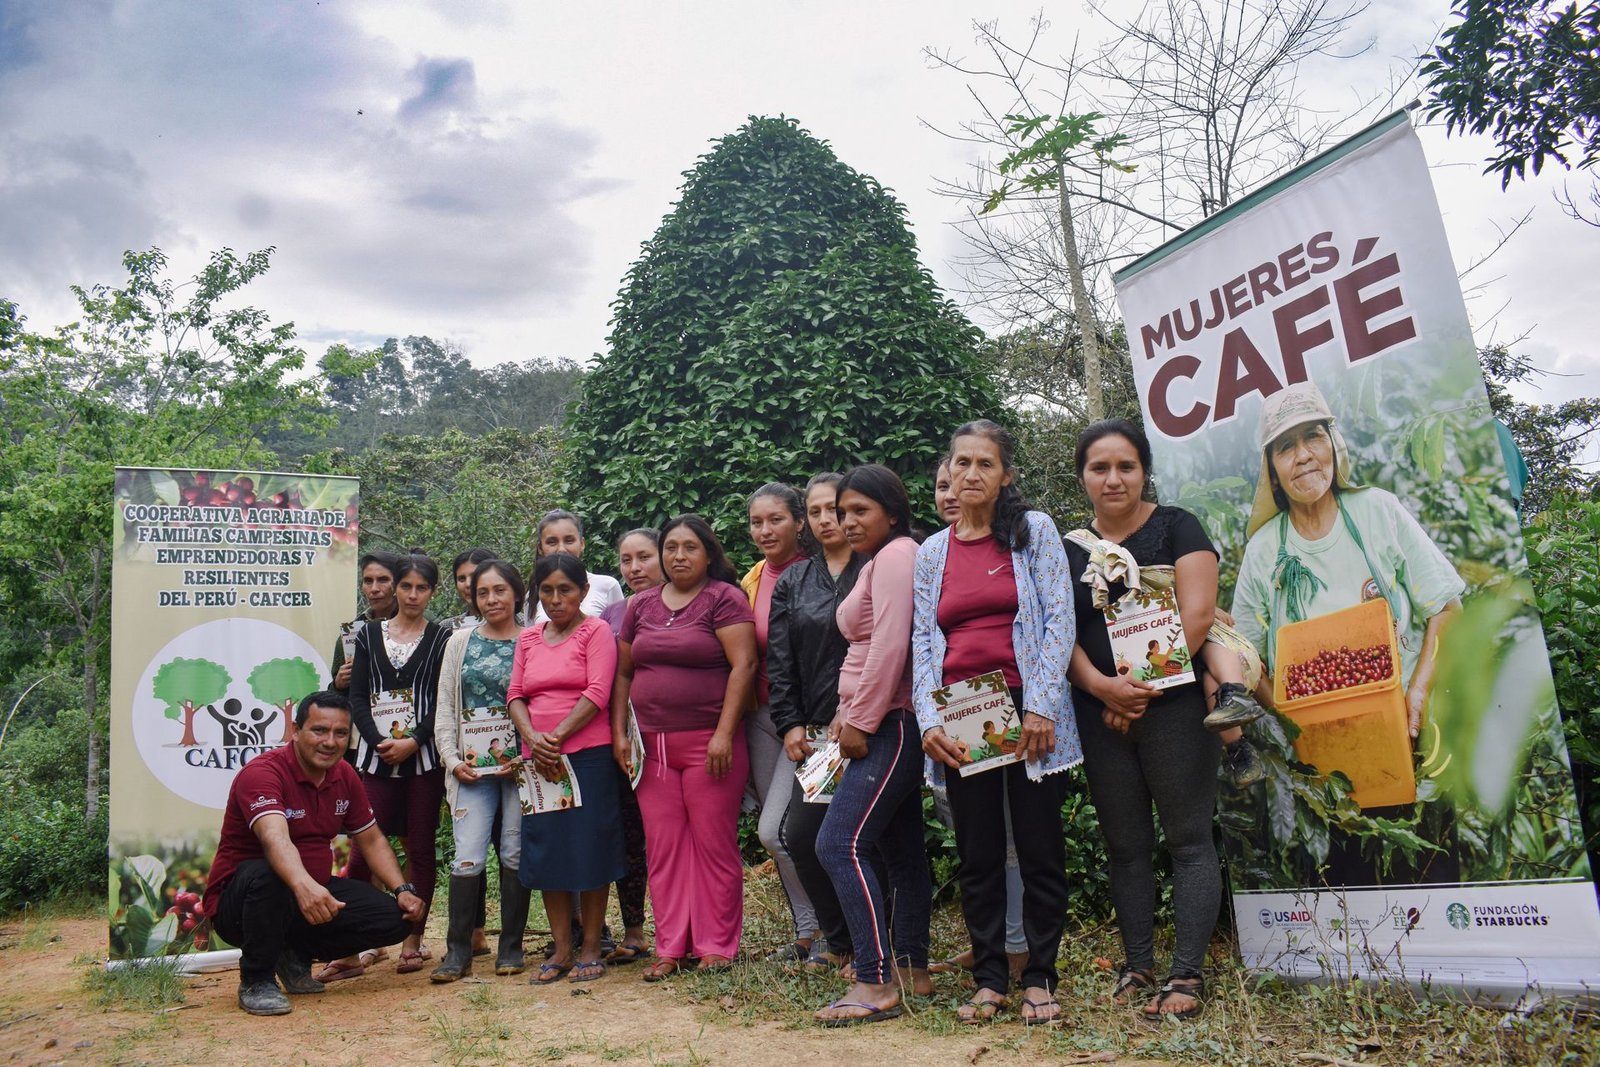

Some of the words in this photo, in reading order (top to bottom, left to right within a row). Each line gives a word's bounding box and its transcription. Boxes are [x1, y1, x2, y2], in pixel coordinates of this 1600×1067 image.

[1140, 231, 1340, 360] MUJERES
[1148, 236, 1417, 437] CAFÉ
[125, 506, 243, 523] COOPERATIVA
[248, 509, 319, 526] AGRARIA
[325, 511, 345, 527] DE
[138, 528, 222, 543] FAMILIAS
[226, 529, 331, 546] CAMPESINAS
[157, 549, 301, 565] EMPRENDEDORAS
[305, 551, 315, 565] Y
[184, 571, 289, 585] RESILIENTES
[160, 591, 191, 606] DEL
[194, 588, 237, 606] PERÚ
[249, 591, 311, 607] CAFCER
[1111, 622, 1148, 640] MUJERES
[1150, 614, 1173, 629] CAFÉ
[373, 708, 394, 717] MUJERES
[395, 705, 410, 713] CAFÉ
[943, 704, 982, 723] MUJERES
[983, 696, 1006, 710] CAFÉ
[465, 726, 492, 735] MUJERES
[494, 723, 510, 732] CAFÉ
[185, 745, 287, 770] CAFC
[534, 781, 545, 810] MUJERES
[1274, 911, 1311, 922] USAID
[1473, 904, 1539, 915] FUNDACIÓN
[1475, 916, 1549, 926] STARBUCKS
